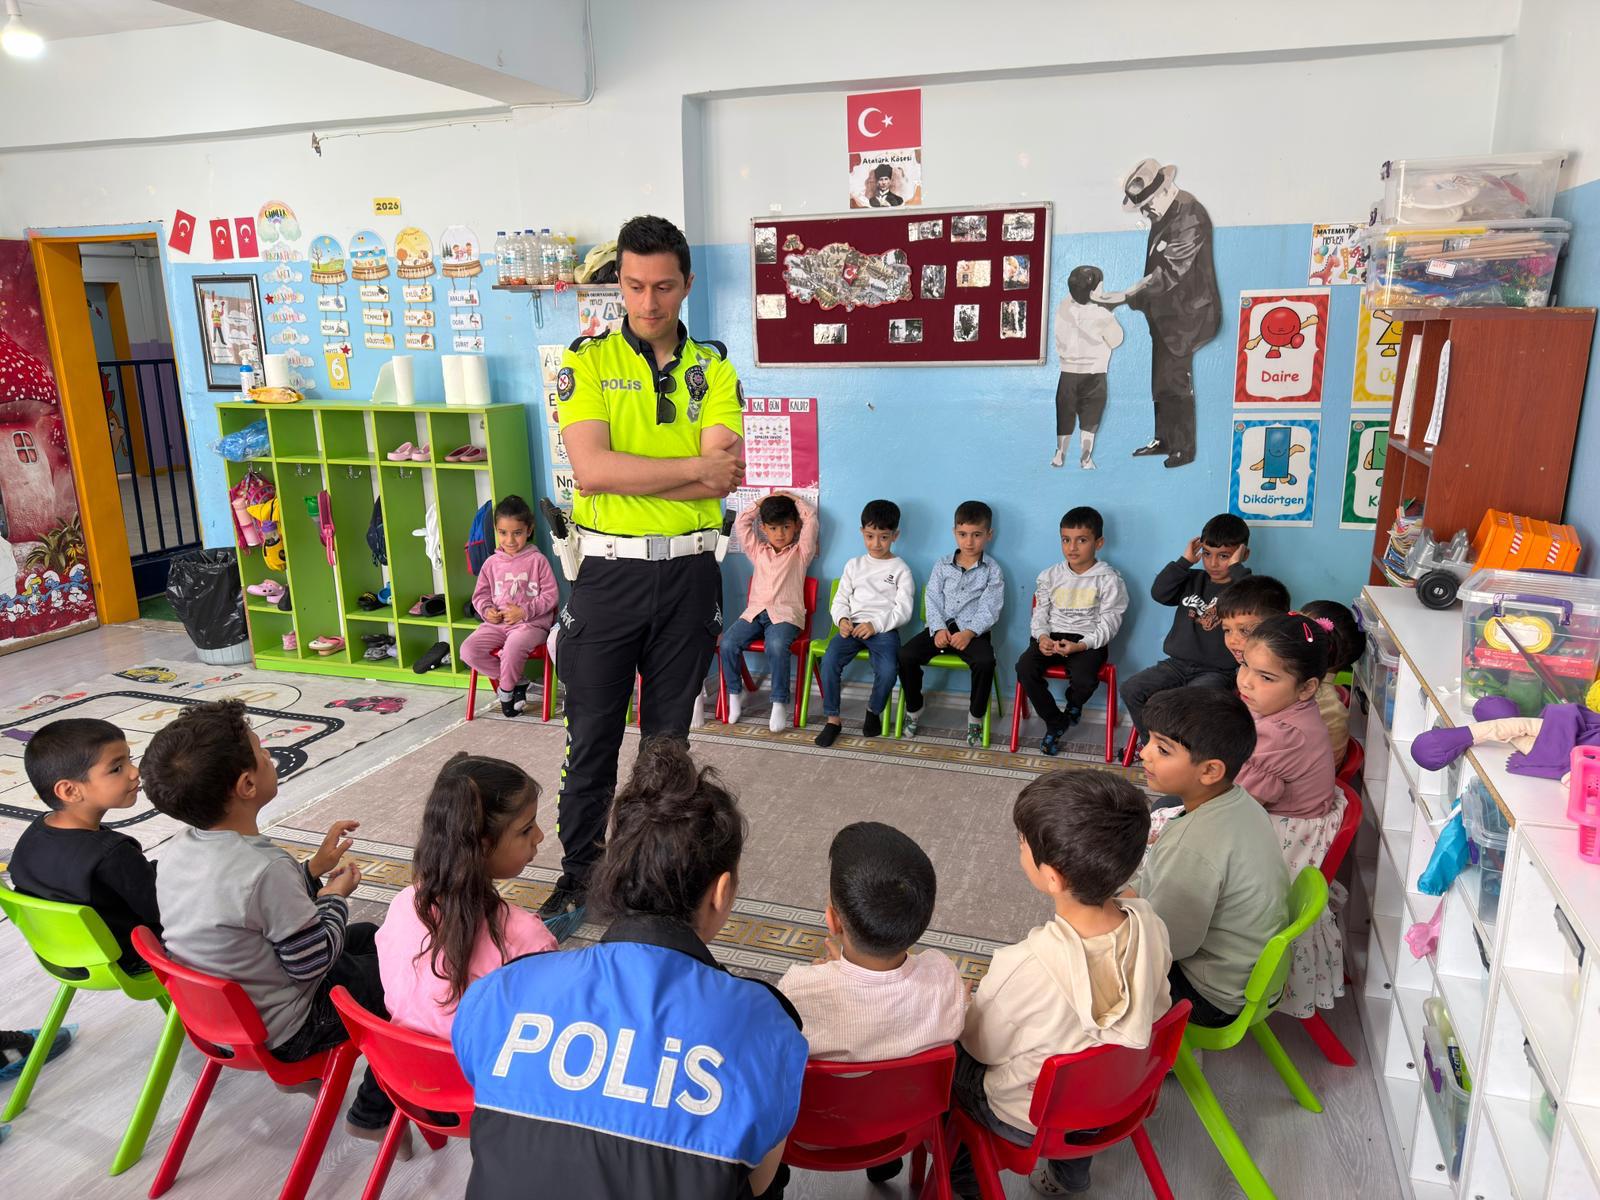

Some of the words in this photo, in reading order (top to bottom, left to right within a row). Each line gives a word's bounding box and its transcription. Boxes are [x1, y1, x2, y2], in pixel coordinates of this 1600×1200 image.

[376, 202, 399, 211] 2026
[331, 358, 345, 380] 6
[1261, 370, 1300, 383] Daire
[556, 476, 573, 488] Nn
[1243, 494, 1304, 507] Dikdörtgen
